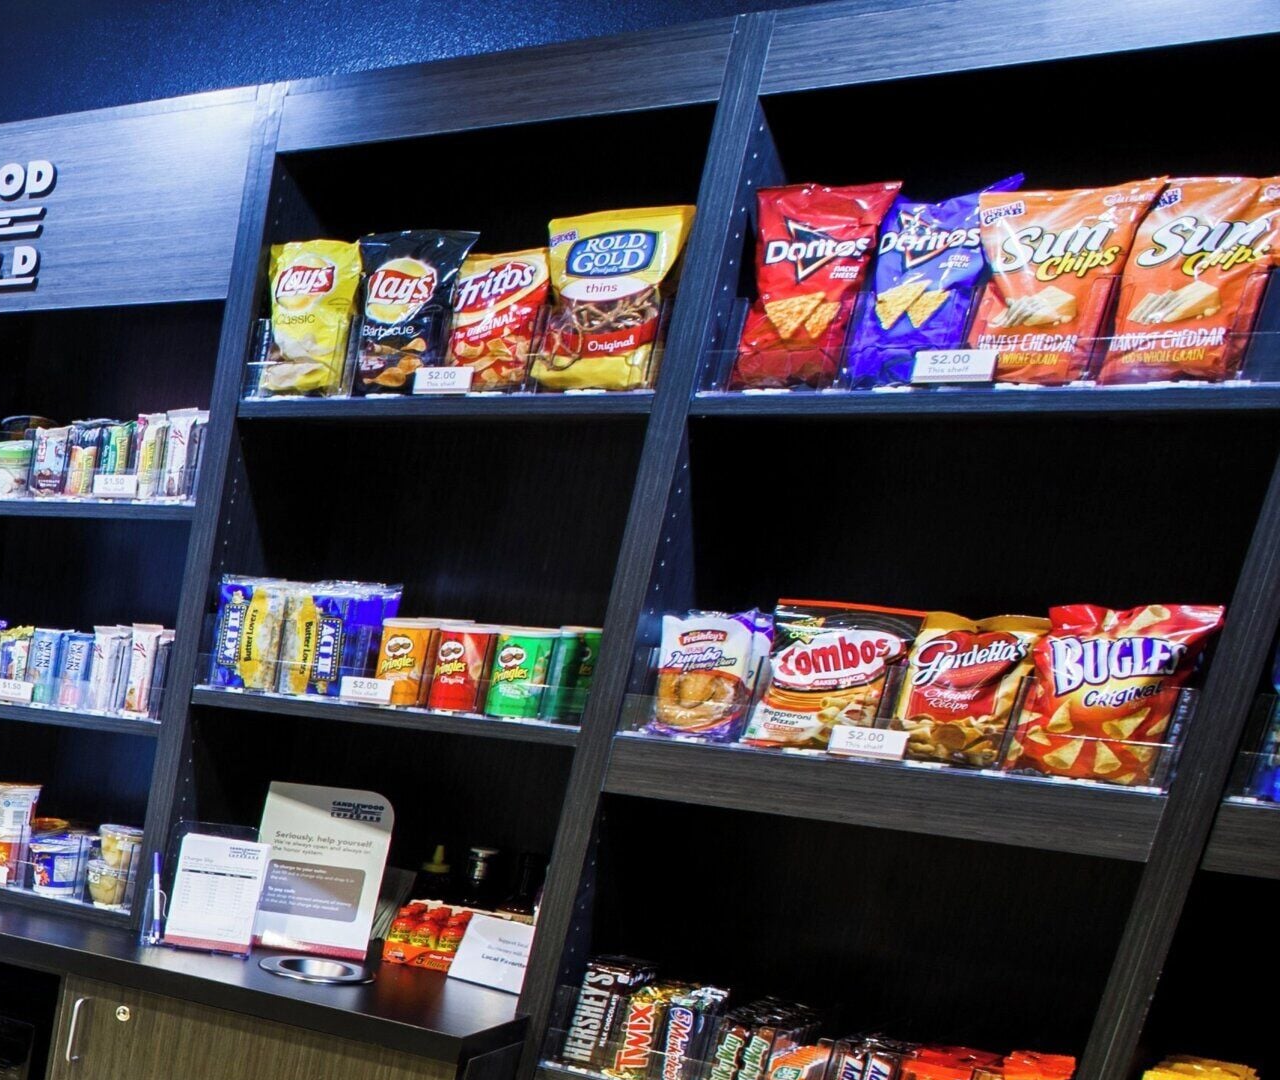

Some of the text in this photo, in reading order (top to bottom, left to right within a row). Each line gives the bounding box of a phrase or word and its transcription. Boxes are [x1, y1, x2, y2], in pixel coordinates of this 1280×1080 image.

[585, 232, 646, 251] ROLD
[765, 236, 871, 264] Doritos
[878, 227, 982, 256] Doritos
[992, 219, 1117, 274] Sun
[1137, 215, 1272, 268] Sun
[572, 249, 646, 274] GOLD
[1036, 245, 1122, 282] Chips
[1182, 244, 1269, 278] Chips
[453, 262, 537, 312] Fritos
[586, 278, 618, 294] thins
[276, 312, 316, 326] Classic
[363, 323, 415, 337] Barbecue
[1161, 327, 1227, 349] CHEDDAR
[587, 335, 635, 352] Original
[930, 354, 970, 365] $2.00
[683, 631, 724, 643] Freshley's
[380, 654, 417, 673] Pringles
[665, 646, 723, 668] Jumbo
[778, 636, 891, 677] Combos
[911, 639, 1031, 687] Gardetto's
[493, 666, 529, 683] Pringles
[1049, 635, 1188, 698] BUGLES
[352, 681, 379, 690] $2.00
[1083, 682, 1163, 709] Original
[763, 708, 813, 721] Pepperoni
[929, 700, 969, 711] Recipe
[770, 717, 799, 726] Pizza
[848, 730, 885, 742] $2.00
[332, 800, 385, 811] CANDLEWOOD
[330, 812, 381, 823] CUPBOARD
[275, 830, 314, 842] Seriously,
[317, 836, 336, 845] help
[415, 955, 425, 966] 5
[562, 971, 615, 1063] HERSHEY'S
[614, 1002, 656, 1073] TWIX
